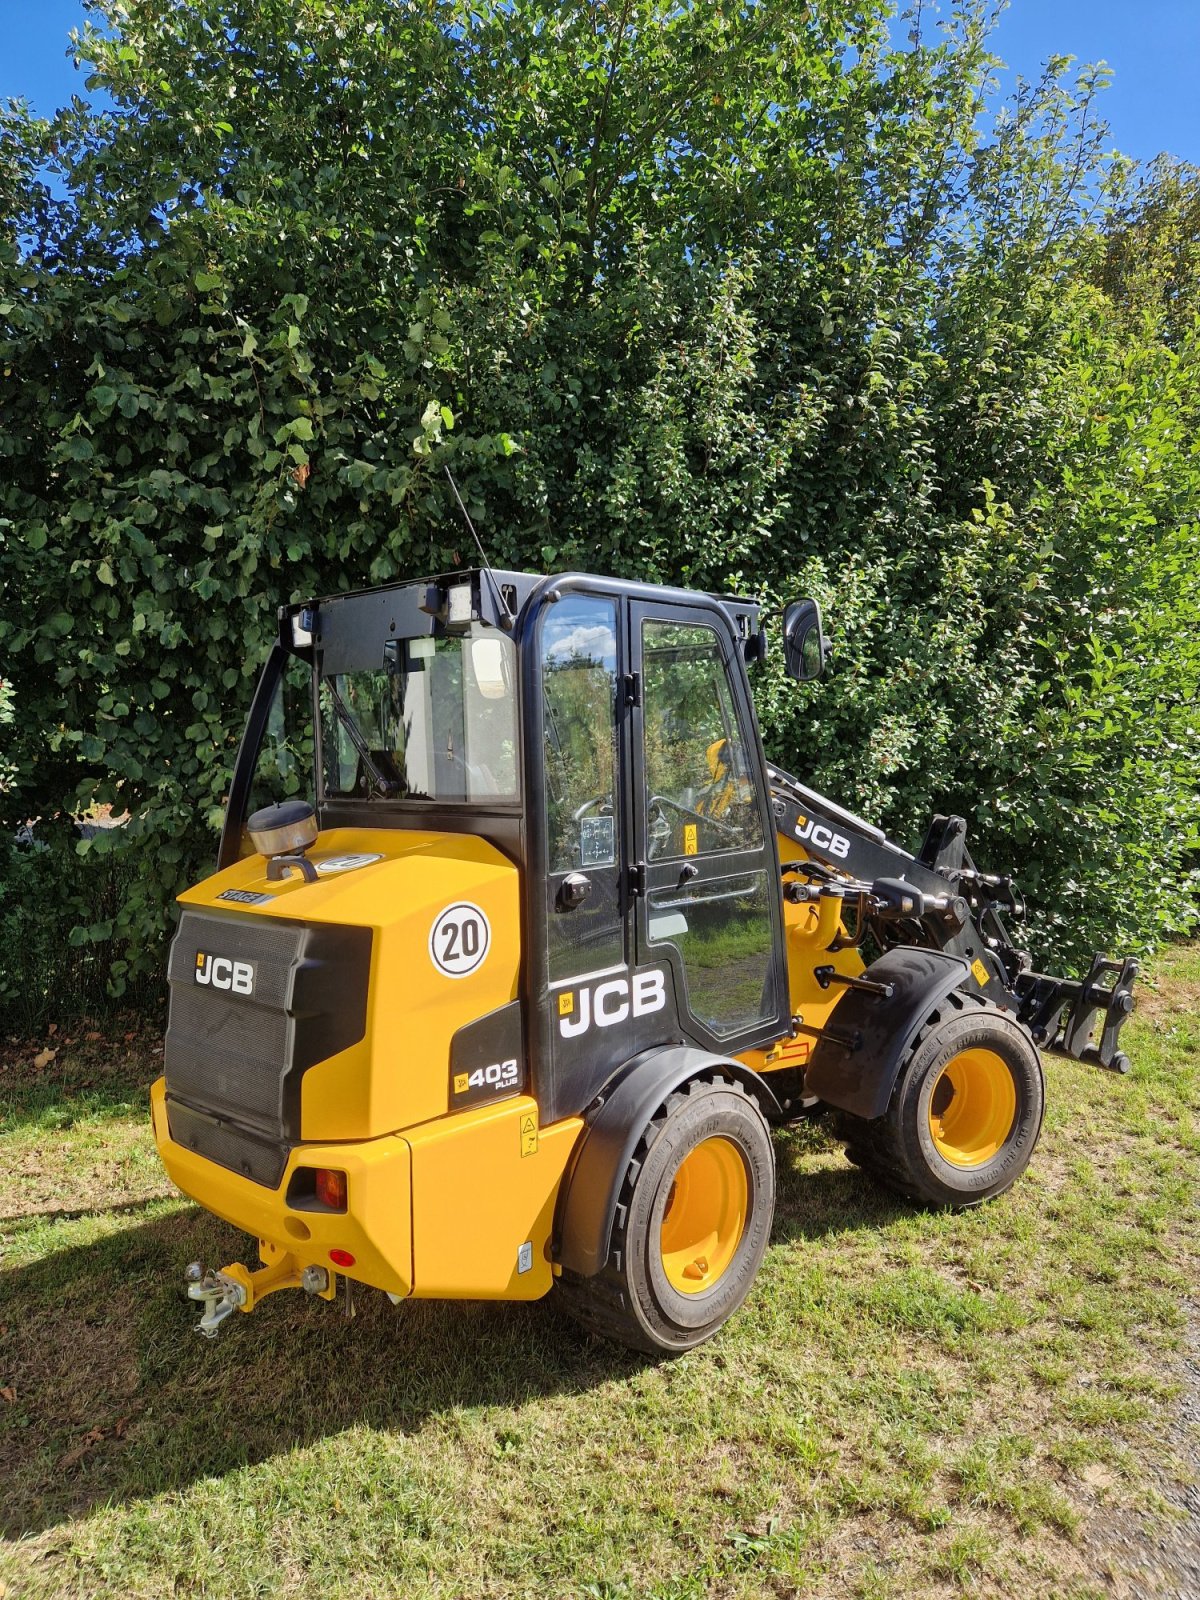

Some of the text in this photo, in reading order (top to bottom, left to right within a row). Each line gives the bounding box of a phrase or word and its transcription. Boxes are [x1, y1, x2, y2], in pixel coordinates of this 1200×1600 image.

[795, 819, 851, 859] JCB
[441, 918, 479, 962] 20
[195, 954, 254, 995] JCB
[559, 969, 666, 1039] JCB
[468, 1059, 518, 1087] 403
[495, 1077, 518, 1090] PLUS
